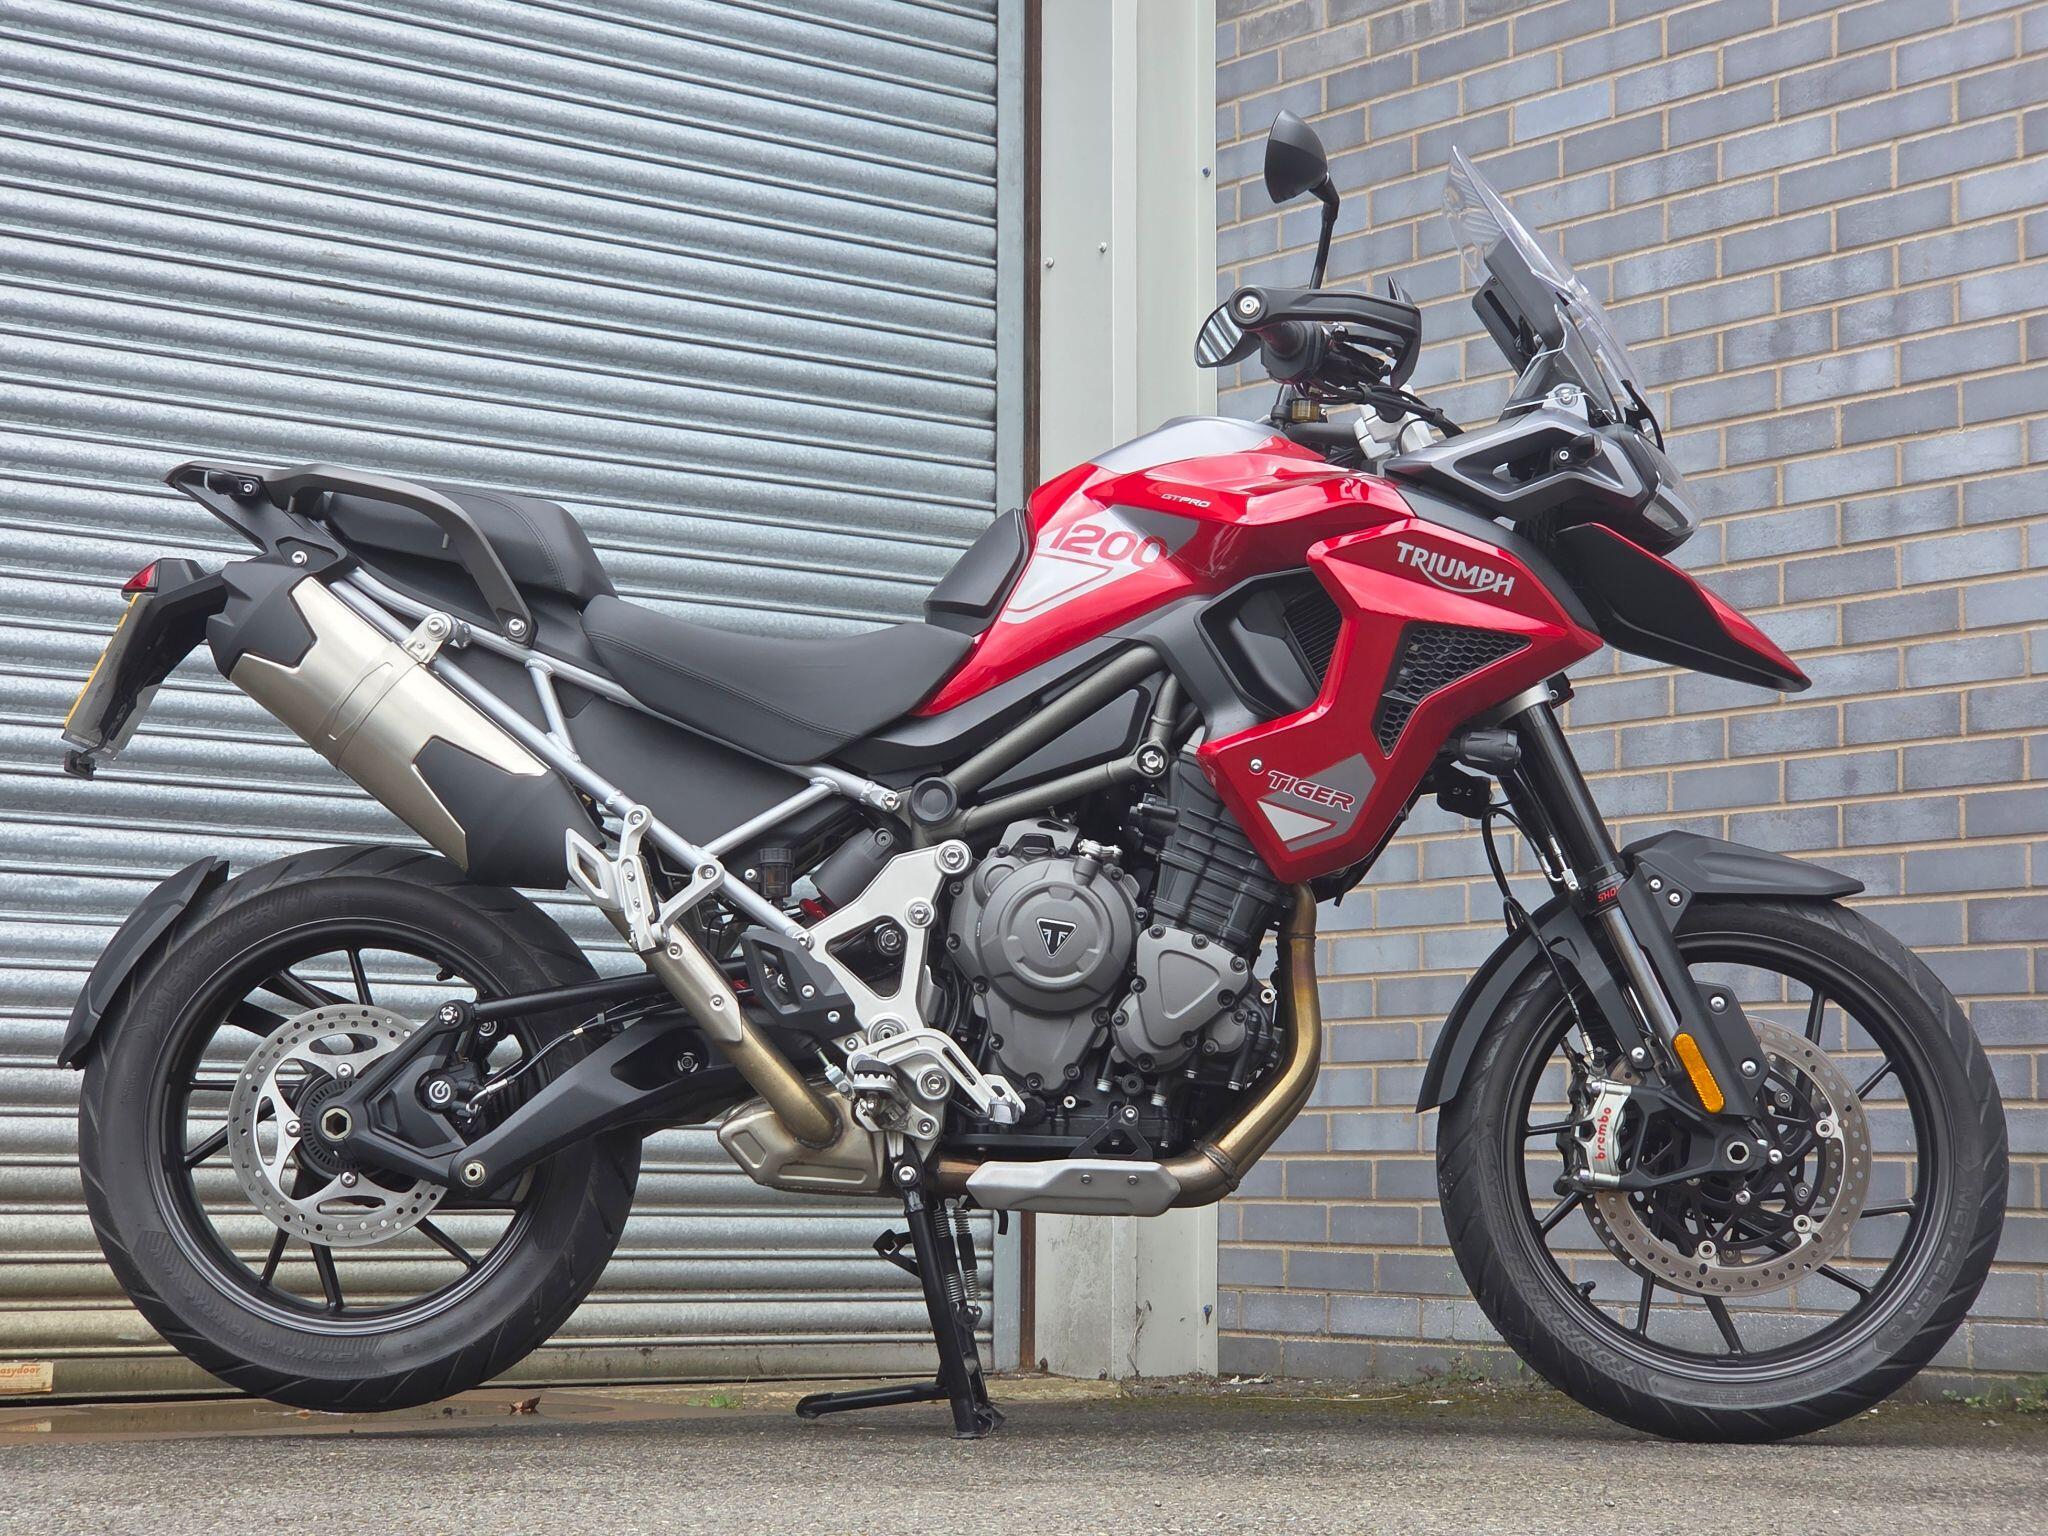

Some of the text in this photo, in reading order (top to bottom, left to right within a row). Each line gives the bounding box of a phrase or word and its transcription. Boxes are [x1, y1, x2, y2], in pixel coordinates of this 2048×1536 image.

[1049, 523, 1169, 568] 1200
[1397, 541, 1515, 597] TRIUMPH
[1268, 770, 1355, 813] TIGER
[1593, 886, 1617, 903] SHO
[1595, 1107, 1612, 1160] brembo
[1903, 1187, 1973, 1324] METZELER
[0, 1364, 41, 1377] asydoor
